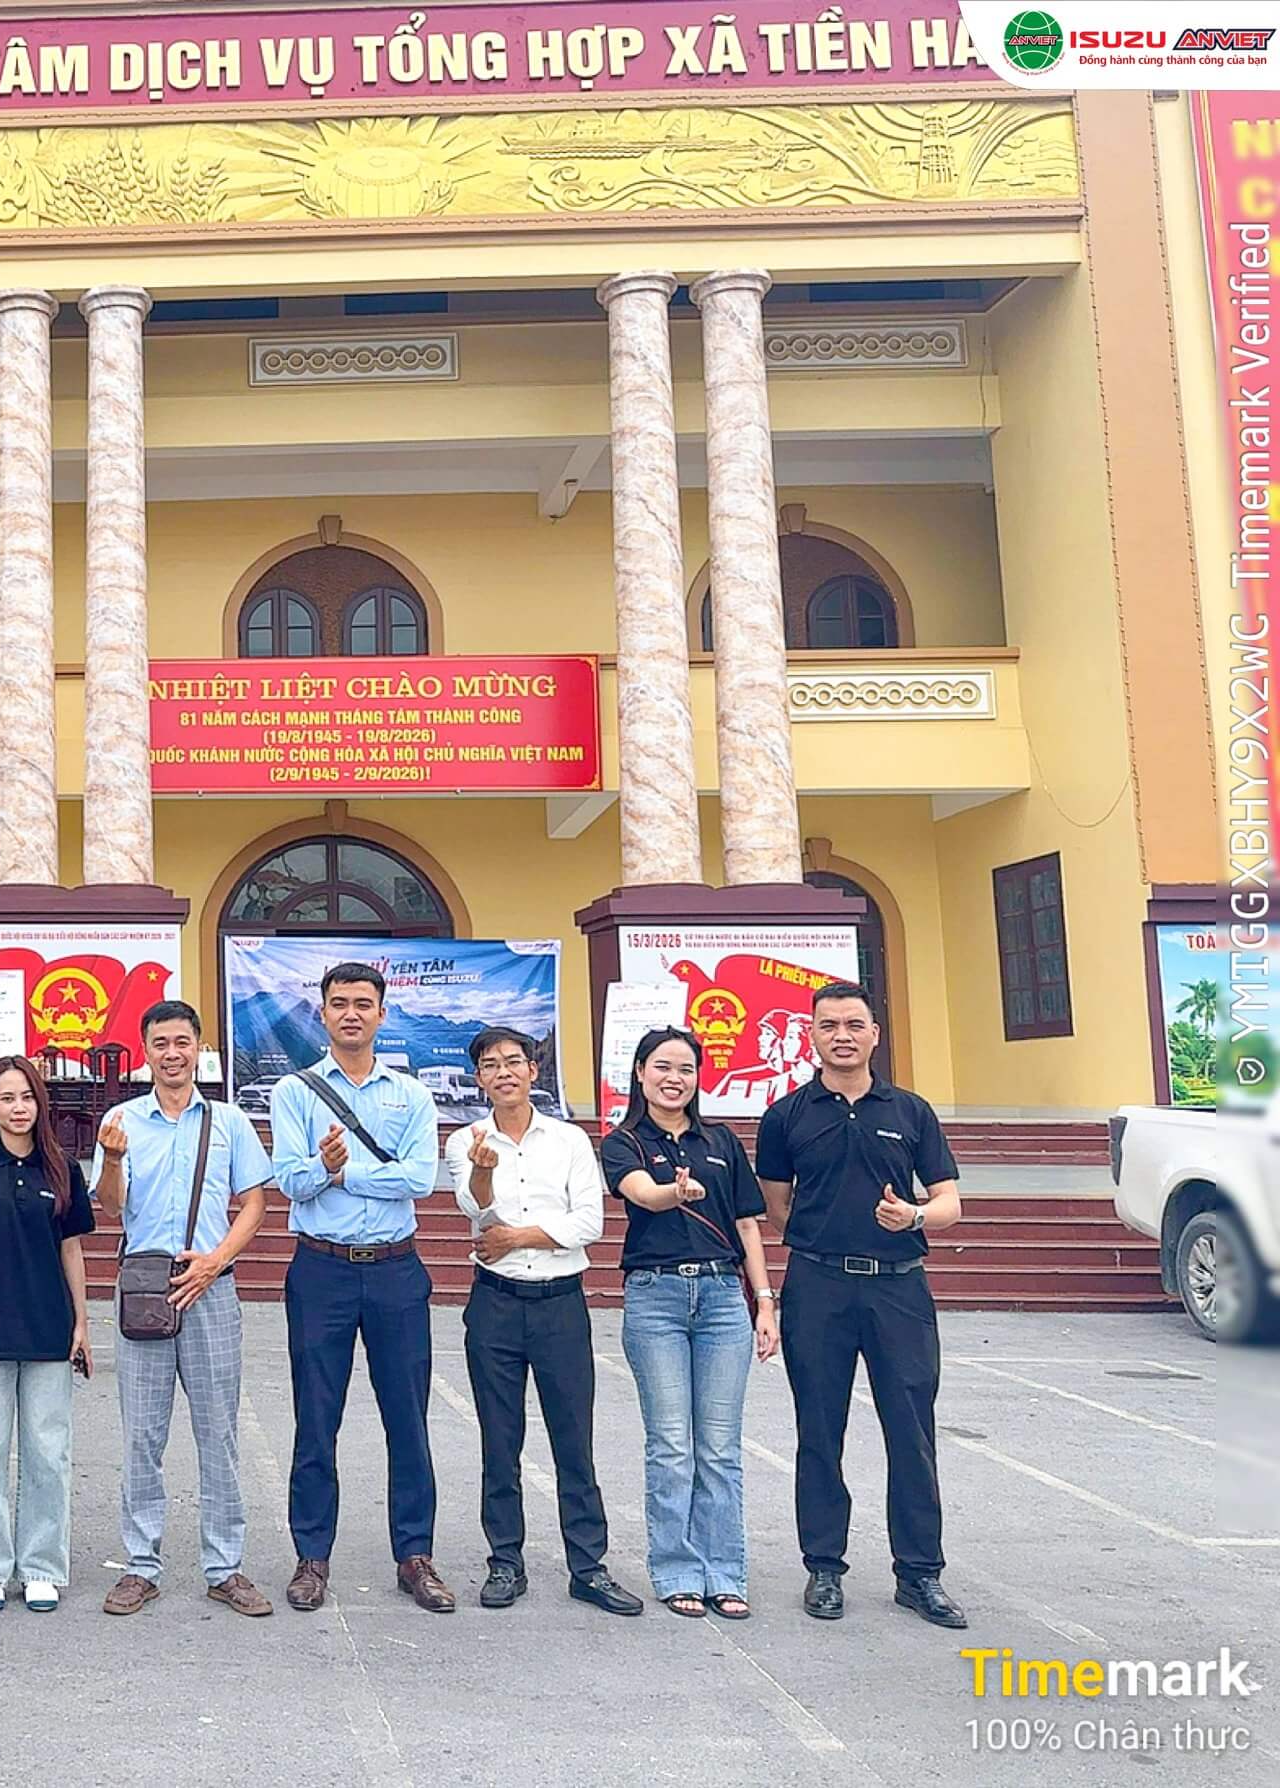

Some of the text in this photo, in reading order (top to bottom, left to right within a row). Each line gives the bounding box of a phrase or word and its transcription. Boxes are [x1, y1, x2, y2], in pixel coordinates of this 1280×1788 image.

[109, 40, 241, 100] DỊCH
[260, 36, 335, 97] VỤ
[353, 11, 507, 85] TỔNG
[527, 22, 645, 91] HỢP
[665, 16, 750, 76] XÃ
[758, 7, 892, 72] TIỀN
[148, 671, 557, 706] NHIỆT LIỆT CHÀO MỪNG
[180, 712, 197, 726] 81
[241, 708, 281, 725] CÁCH
[334, 708, 384, 725] THÁNG
[387, 707, 420, 724] TÁM
[424, 706, 475, 724] THÀNH
[478, 706, 522, 724] CÔNG
[263, 730, 341, 745] (19/8/1945
[357, 728, 436, 743] 19/8/2026)
[189, 746, 240, 763] KHÁNH
[243, 744, 285, 763] NƯỚC
[289, 746, 330, 766] CỘNG
[369, 745, 390, 762] XÃ
[394, 744, 419, 765] HỘI
[423, 742, 454, 761] CHỦ
[458, 744, 506, 761] NGHĨA
[509, 744, 543, 764] VIỆT
[547, 746, 584, 761] NAM
[270, 767, 339, 783] (2/9/1945
[354, 766, 431, 782] 2/9/2026)!
[626, 933, 682, 948] 15/3/2026
[391, 960, 419, 975] YÊN
[421, 957, 455, 973] TÂM
[759, 957, 774, 976] LÁ
